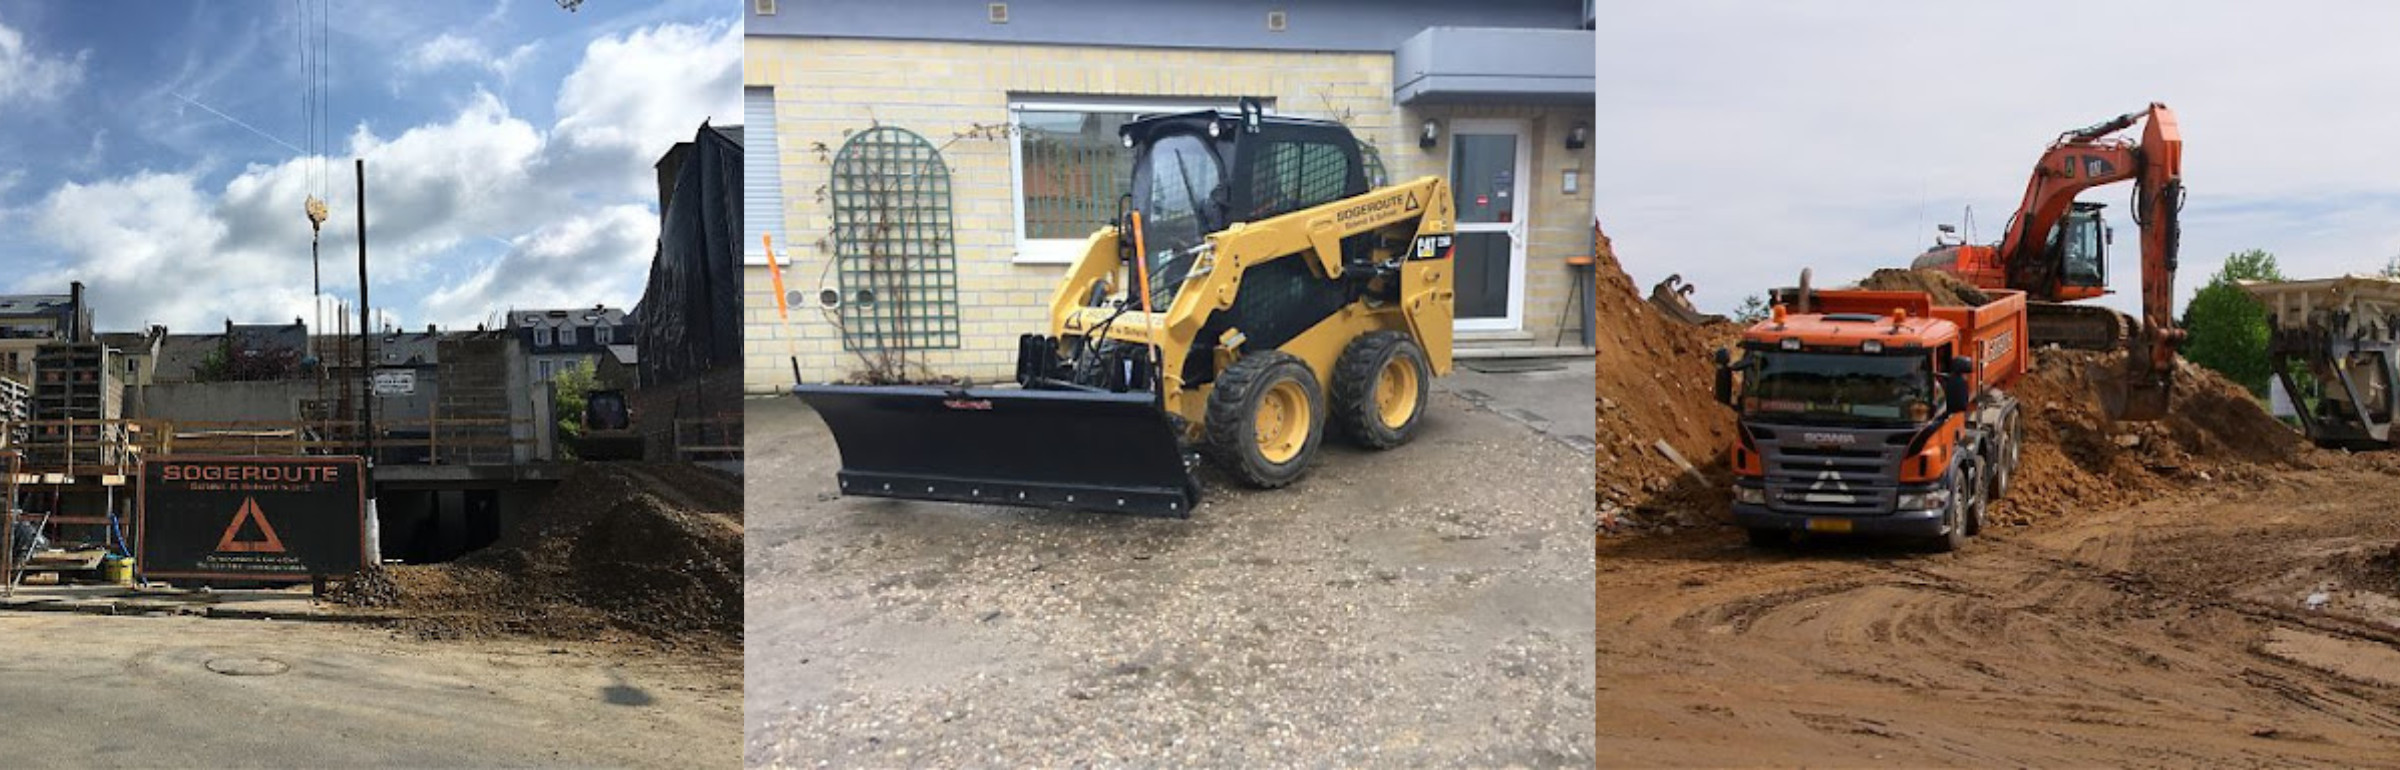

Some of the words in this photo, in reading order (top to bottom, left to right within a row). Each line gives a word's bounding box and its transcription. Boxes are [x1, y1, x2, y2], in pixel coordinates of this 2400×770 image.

[1337, 194, 1403, 221] SOGEROUTE
[1417, 236, 1437, 258] CAT
[1803, 432, 1857, 446] SCANIA
[162, 464, 339, 482] SOGEROUTE
